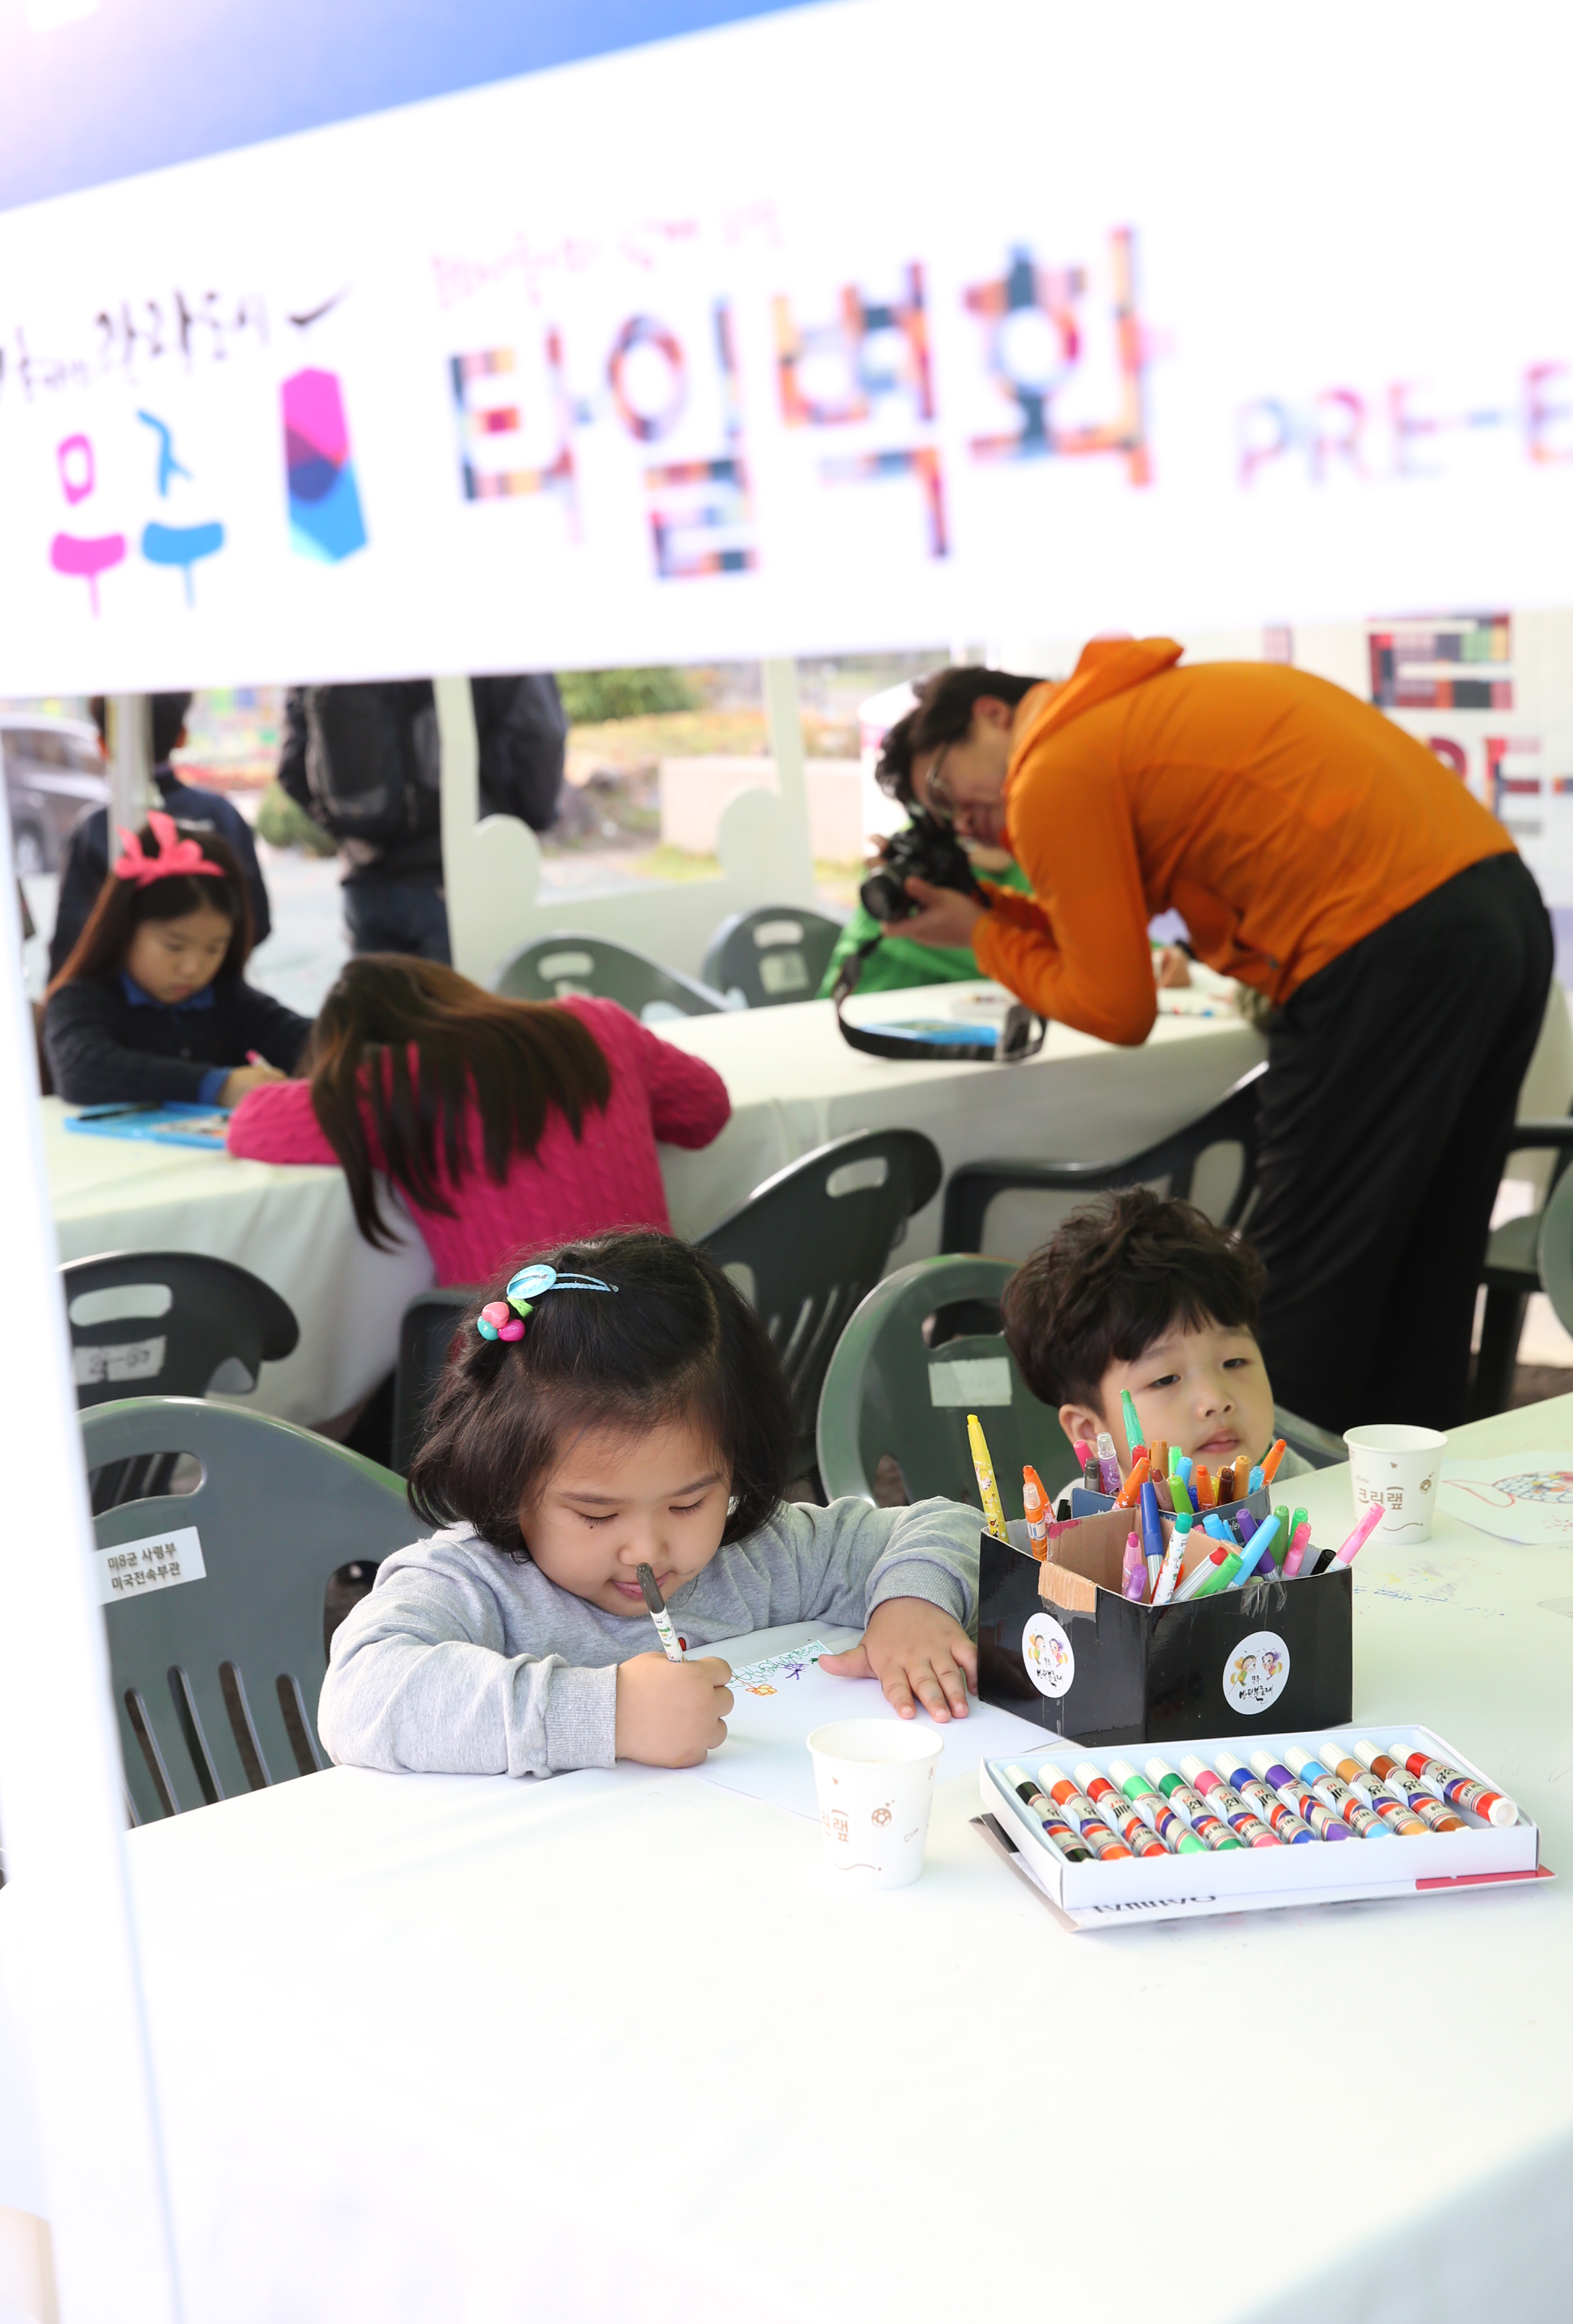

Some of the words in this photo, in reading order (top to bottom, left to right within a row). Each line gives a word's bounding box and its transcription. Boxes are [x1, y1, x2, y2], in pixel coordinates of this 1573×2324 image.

[444, 224, 1176, 582] 타일벽화
[108, 1552, 138, 1570] 미8군
[141, 1542, 176, 1561] 사령부
